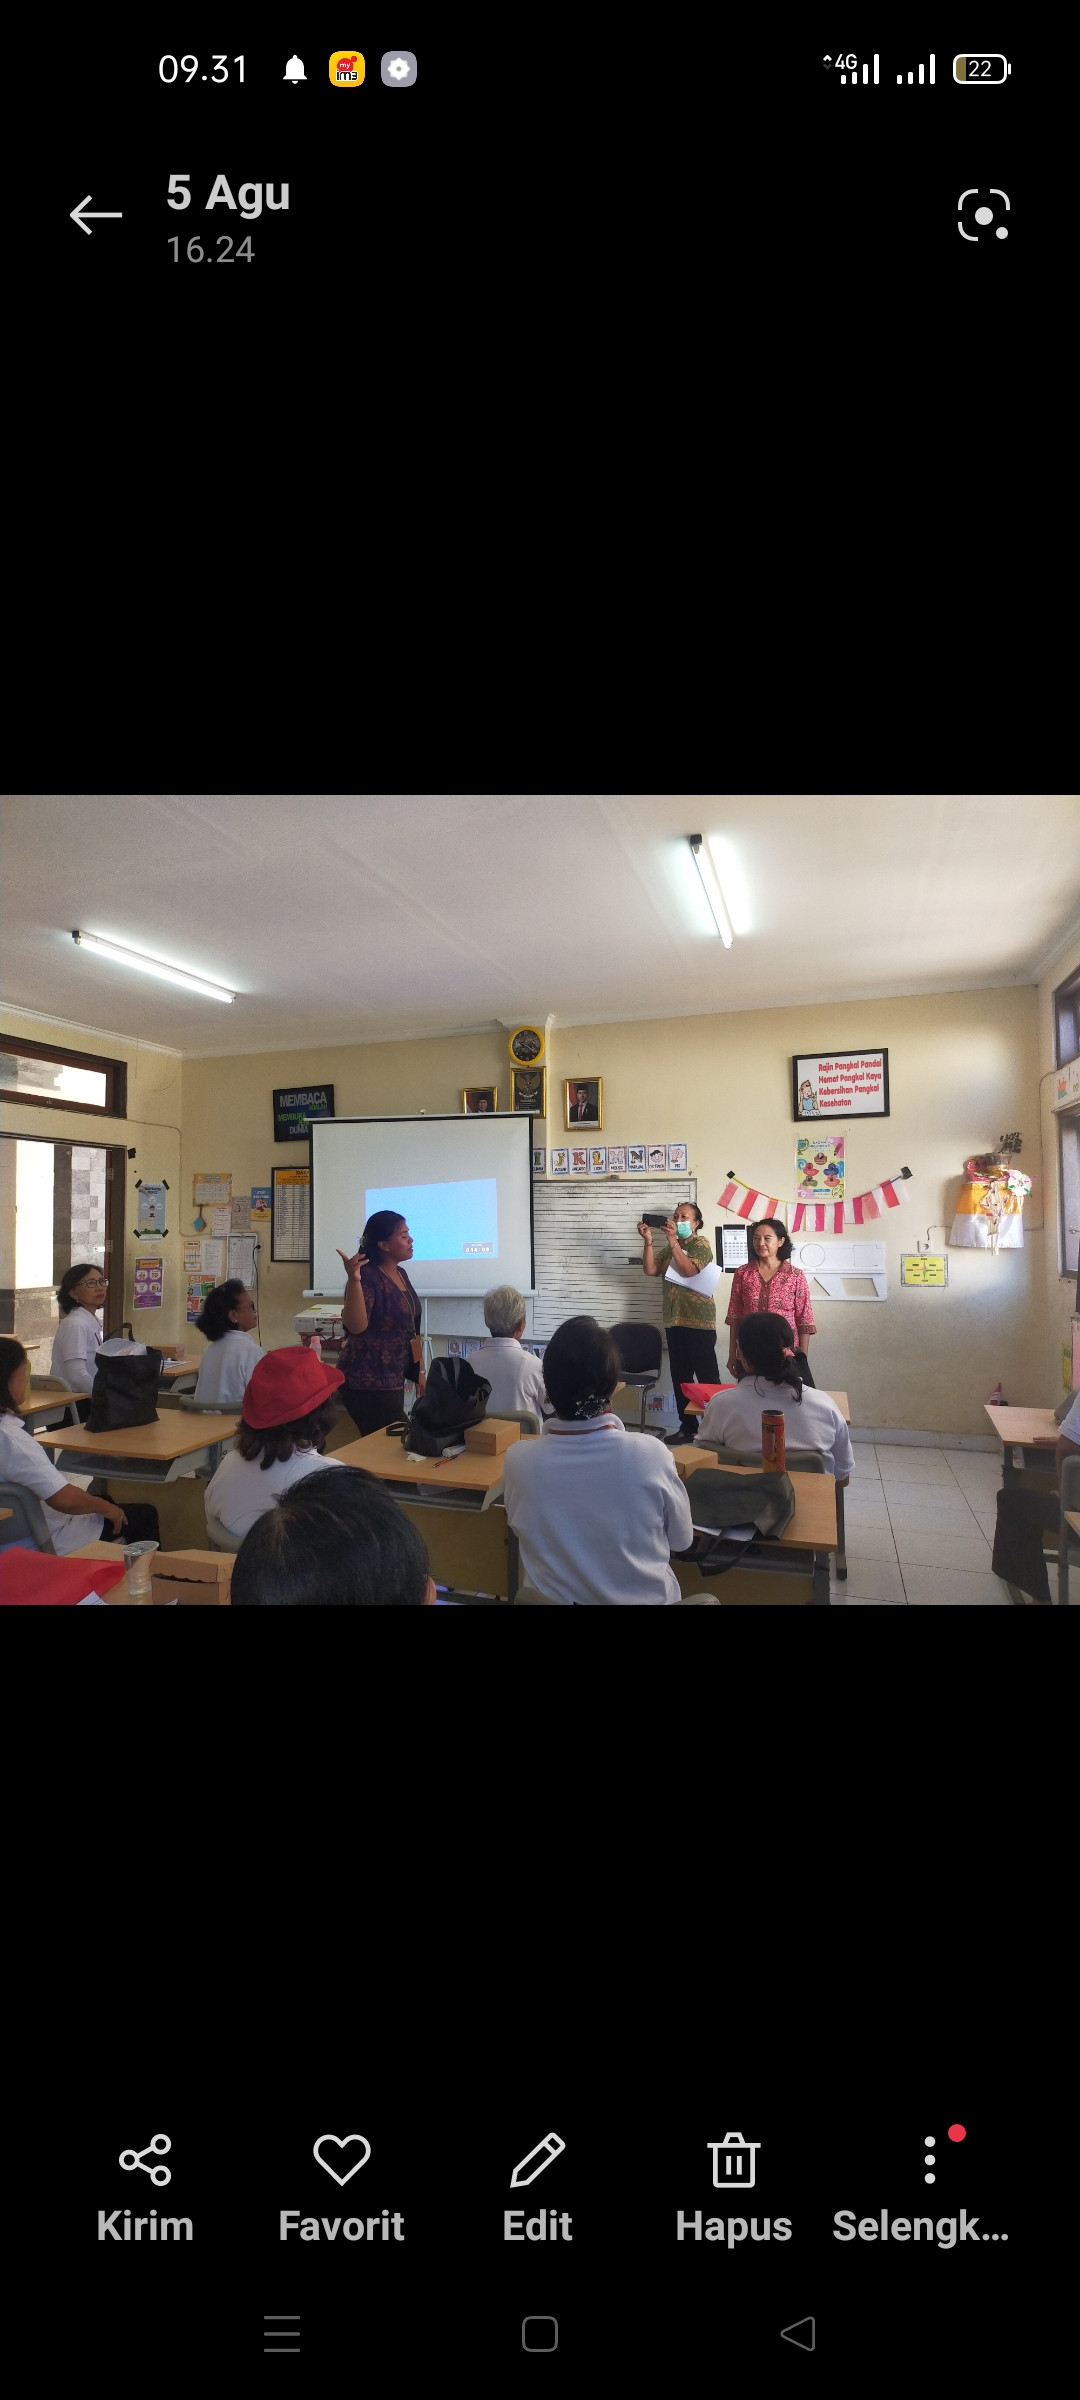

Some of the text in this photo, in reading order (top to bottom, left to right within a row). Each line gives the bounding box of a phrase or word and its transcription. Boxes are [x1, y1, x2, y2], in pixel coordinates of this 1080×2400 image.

[818, 1058, 882, 1073] Rajin Pangkal Pandai
[818, 1072, 882, 1084] Hemat Pangkal Kaya
[819, 1084, 880, 1096] Kebersihan Pangkal
[280, 1092, 328, 1108] MEMBACA
[820, 1098, 852, 1108] Kesehatan
[290, 1126, 308, 1134] DUNIA
[572, 1152, 586, 1166] K
[592, 1150, 604, 1166] L
